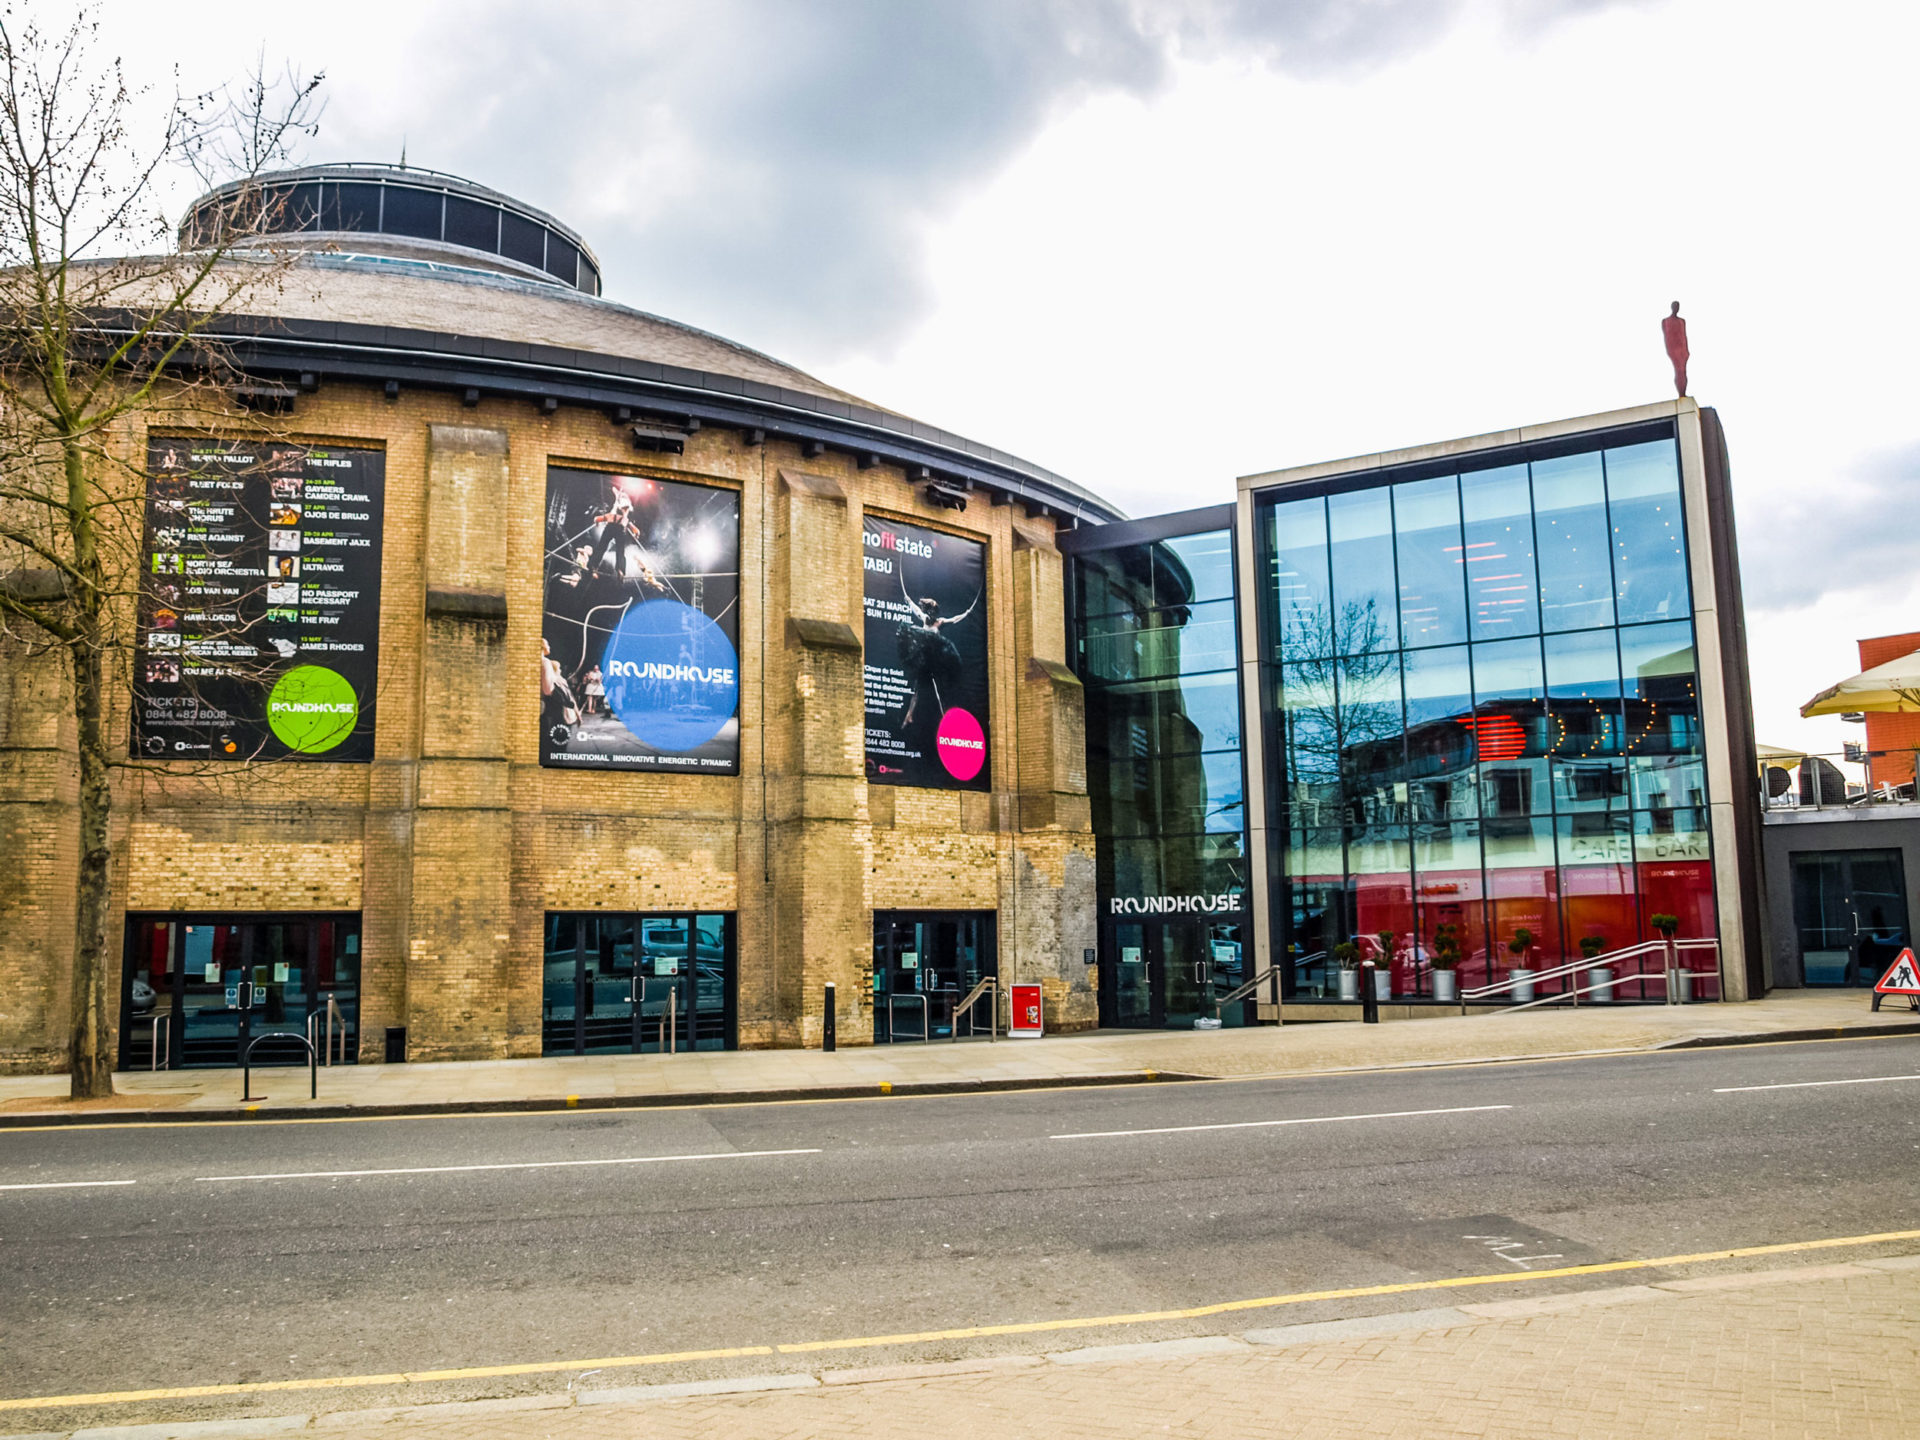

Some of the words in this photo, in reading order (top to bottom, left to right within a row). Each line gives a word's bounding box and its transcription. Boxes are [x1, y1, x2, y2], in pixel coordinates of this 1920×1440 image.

[302, 564, 344, 572] ULTRAVOX
[863, 556, 892, 574] TABÚ
[316, 590, 359, 599] PASSPORT
[877, 599, 885, 608] 28
[886, 601, 912, 614] MARCH
[867, 608, 882, 619] SUN
[883, 612, 891, 620] 19
[893, 613, 914, 624] APRIL
[609, 660, 734, 684] ROUNDHOUSE
[891, 677, 908, 686] Disney
[888, 692, 903, 701] future
[271, 703, 354, 712] ROUNDHOUSE
[869, 698, 885, 707] British
[879, 739, 889, 747] 482
[891, 740, 905, 748] 8008
[939, 736, 983, 749] ROUNDHOUSE
[550, 753, 609, 762] INTERNATIONAL
[613, 755, 655, 764] INNOVATIVE
[658, 757, 698, 765] ENERGETIC
[700, 759, 732, 767] DYNAMIC
[1111, 894, 1241, 914] ROUNDHOUSE
